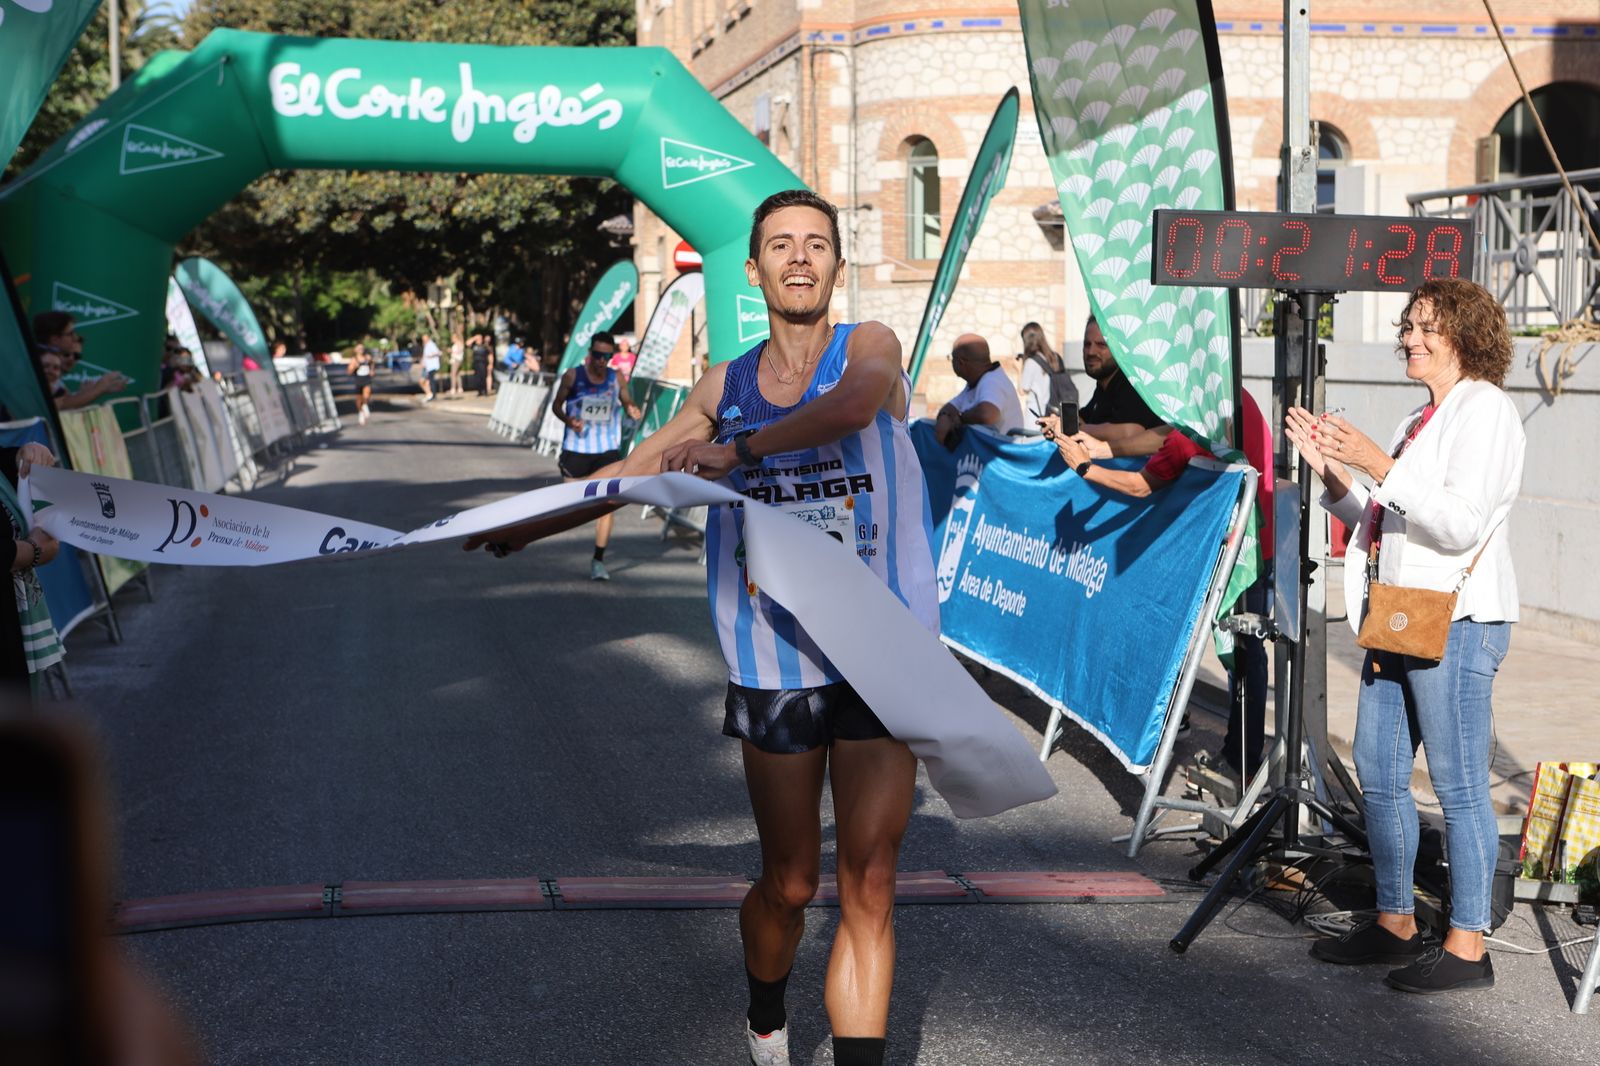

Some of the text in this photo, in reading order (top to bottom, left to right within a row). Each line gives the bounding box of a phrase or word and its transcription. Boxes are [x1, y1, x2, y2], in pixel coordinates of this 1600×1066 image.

[269, 62, 623, 144] El Corte Inglés
[585, 405, 608, 415] 471
[743, 459, 843, 480] ATLETISMO
[212, 516, 271, 539] Asociación de la
[207, 531, 270, 552] Prensa de Málaga
[971, 513, 1108, 599] Ayuntamiento de Málaga
[958, 561, 1027, 618] Área de Deporte
